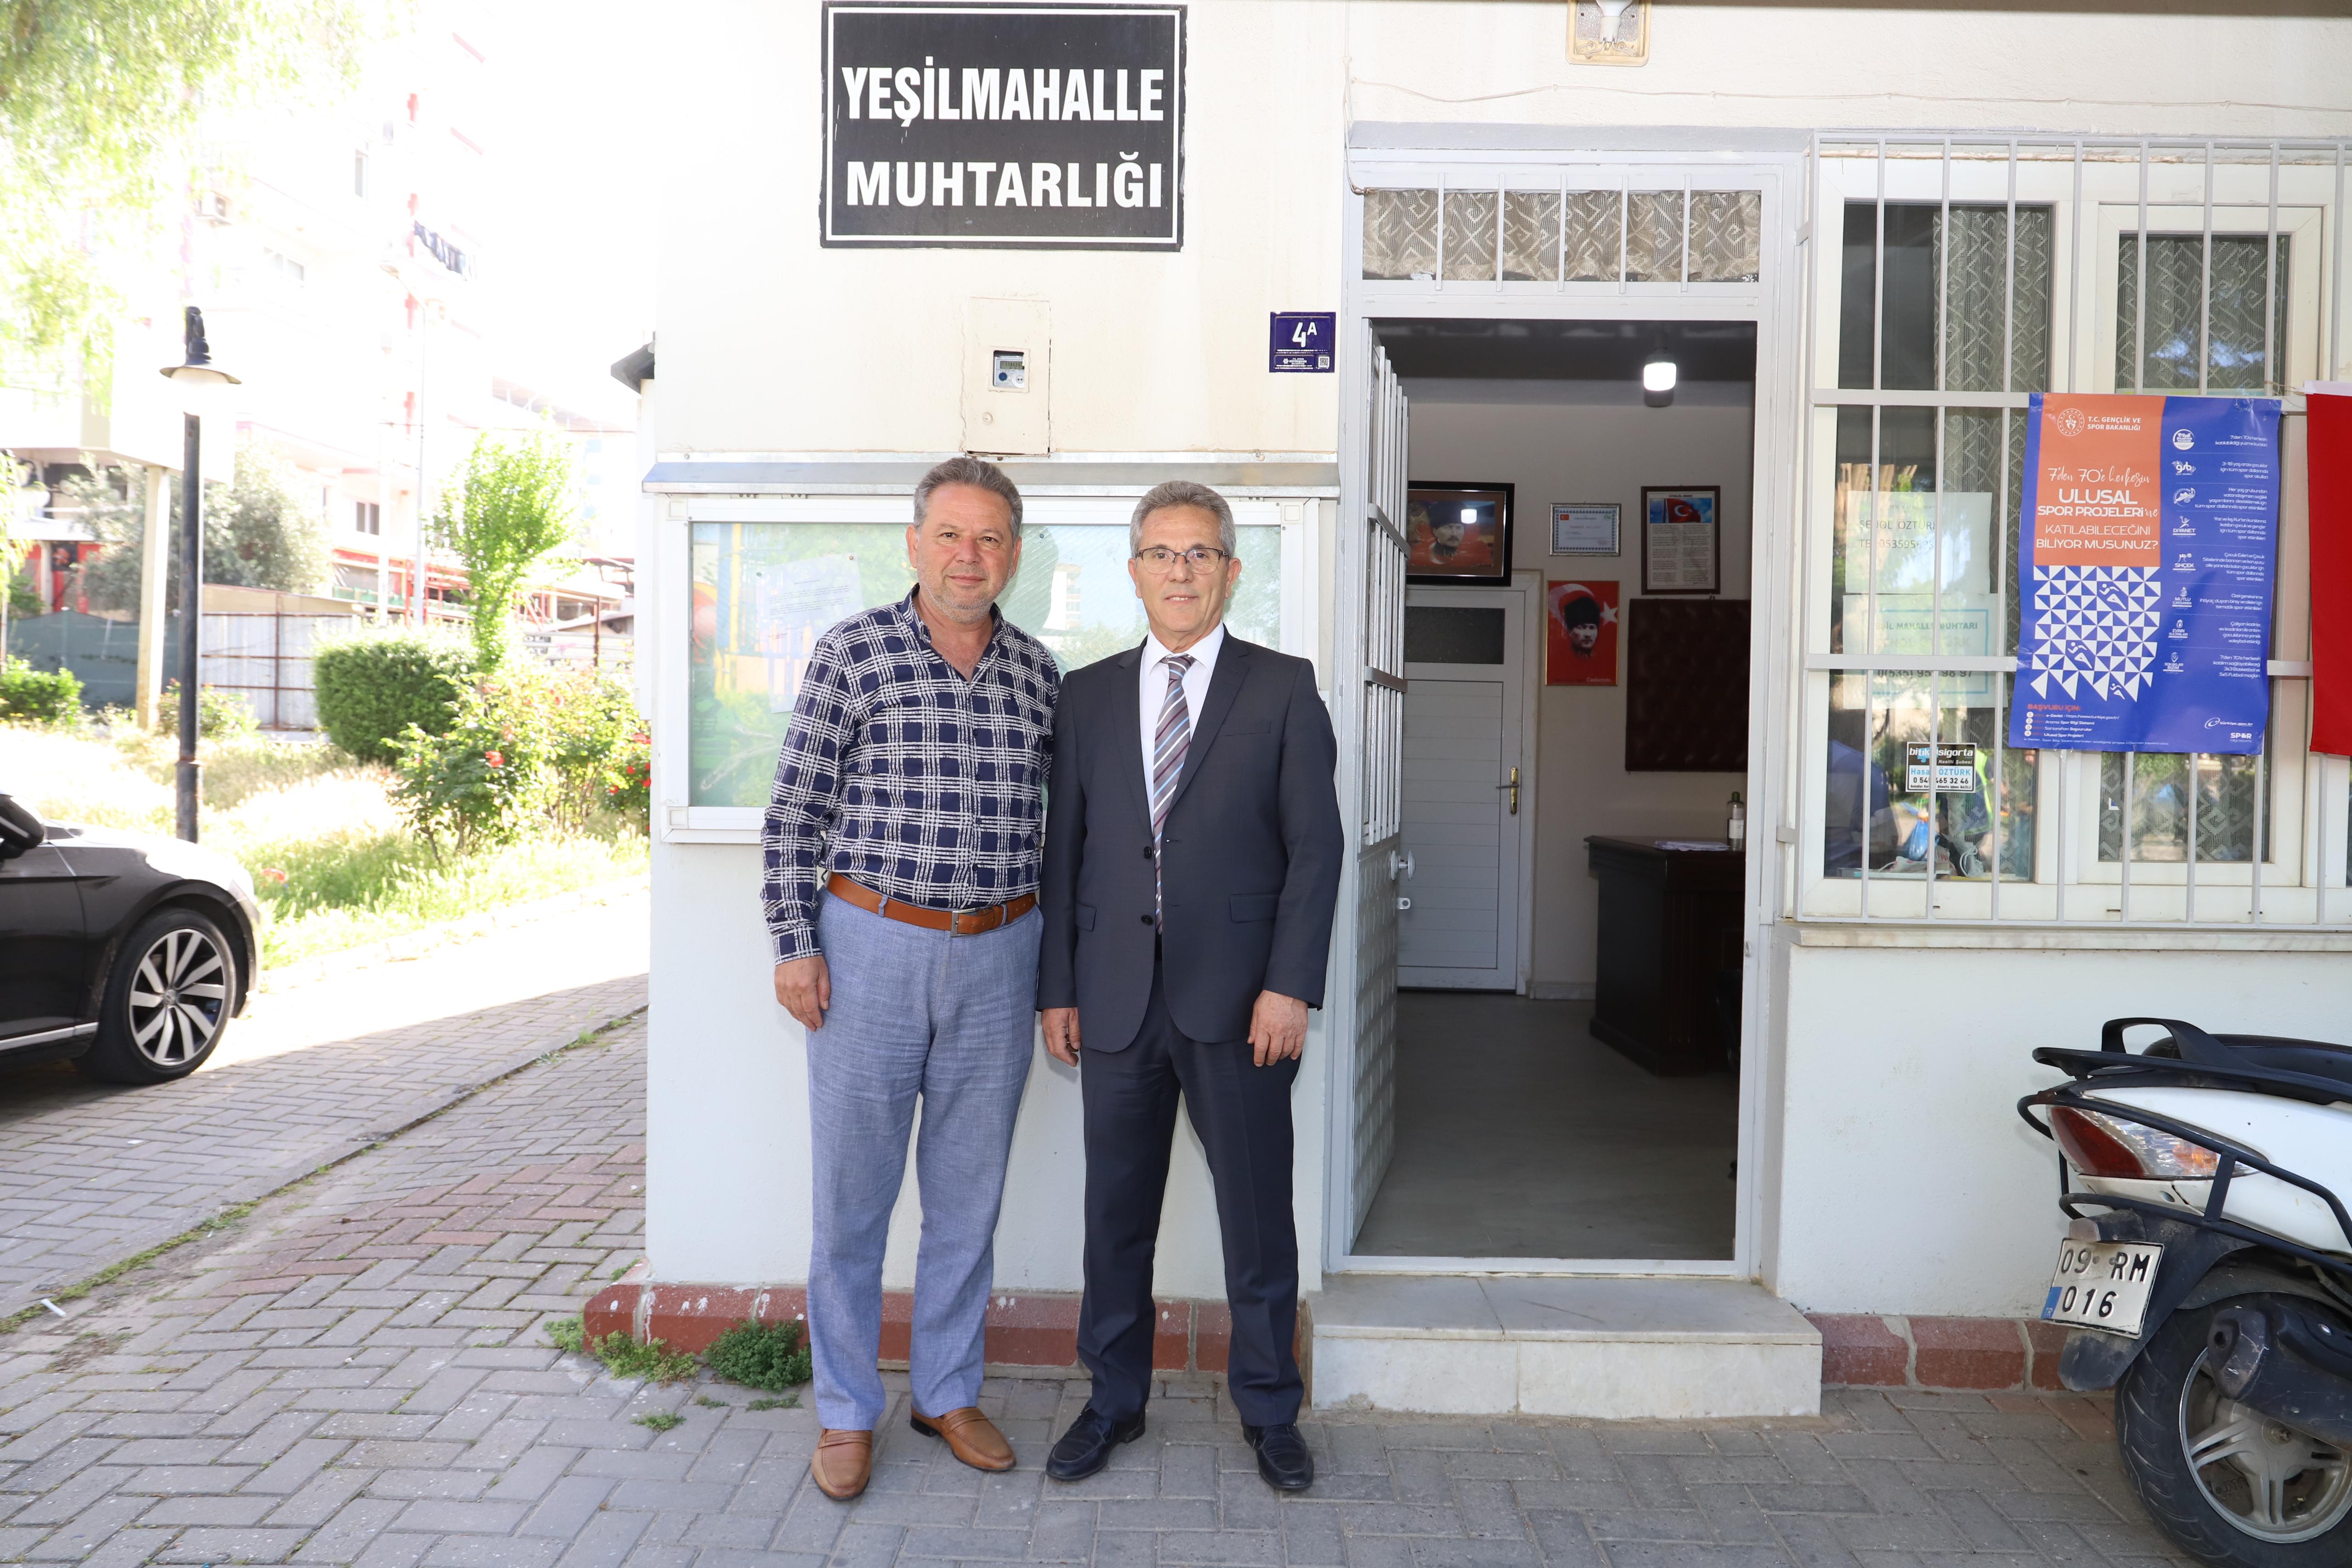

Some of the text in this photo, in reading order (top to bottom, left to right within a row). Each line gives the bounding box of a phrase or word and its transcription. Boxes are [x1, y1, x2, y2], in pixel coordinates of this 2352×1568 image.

[842, 56, 1164, 127] YEŞİLMAHALLE
[847, 151, 1162, 208] MUHTARLIĞI
[2109, 466, 2150, 487] herkesin
[2058, 488, 2138, 505] ULUSAL
[2037, 506, 2073, 516] SPOR
[2045, 524, 2151, 536] KATILABİLECEĞİNİ
[2036, 537, 2159, 550] BİLİYOR MUSUNUZ?
[1939, 767, 1971, 775] ÖZTÜRK
[2061, 1248, 2153, 1284] 09 RM
[2062, 1286, 2117, 1318] 016
